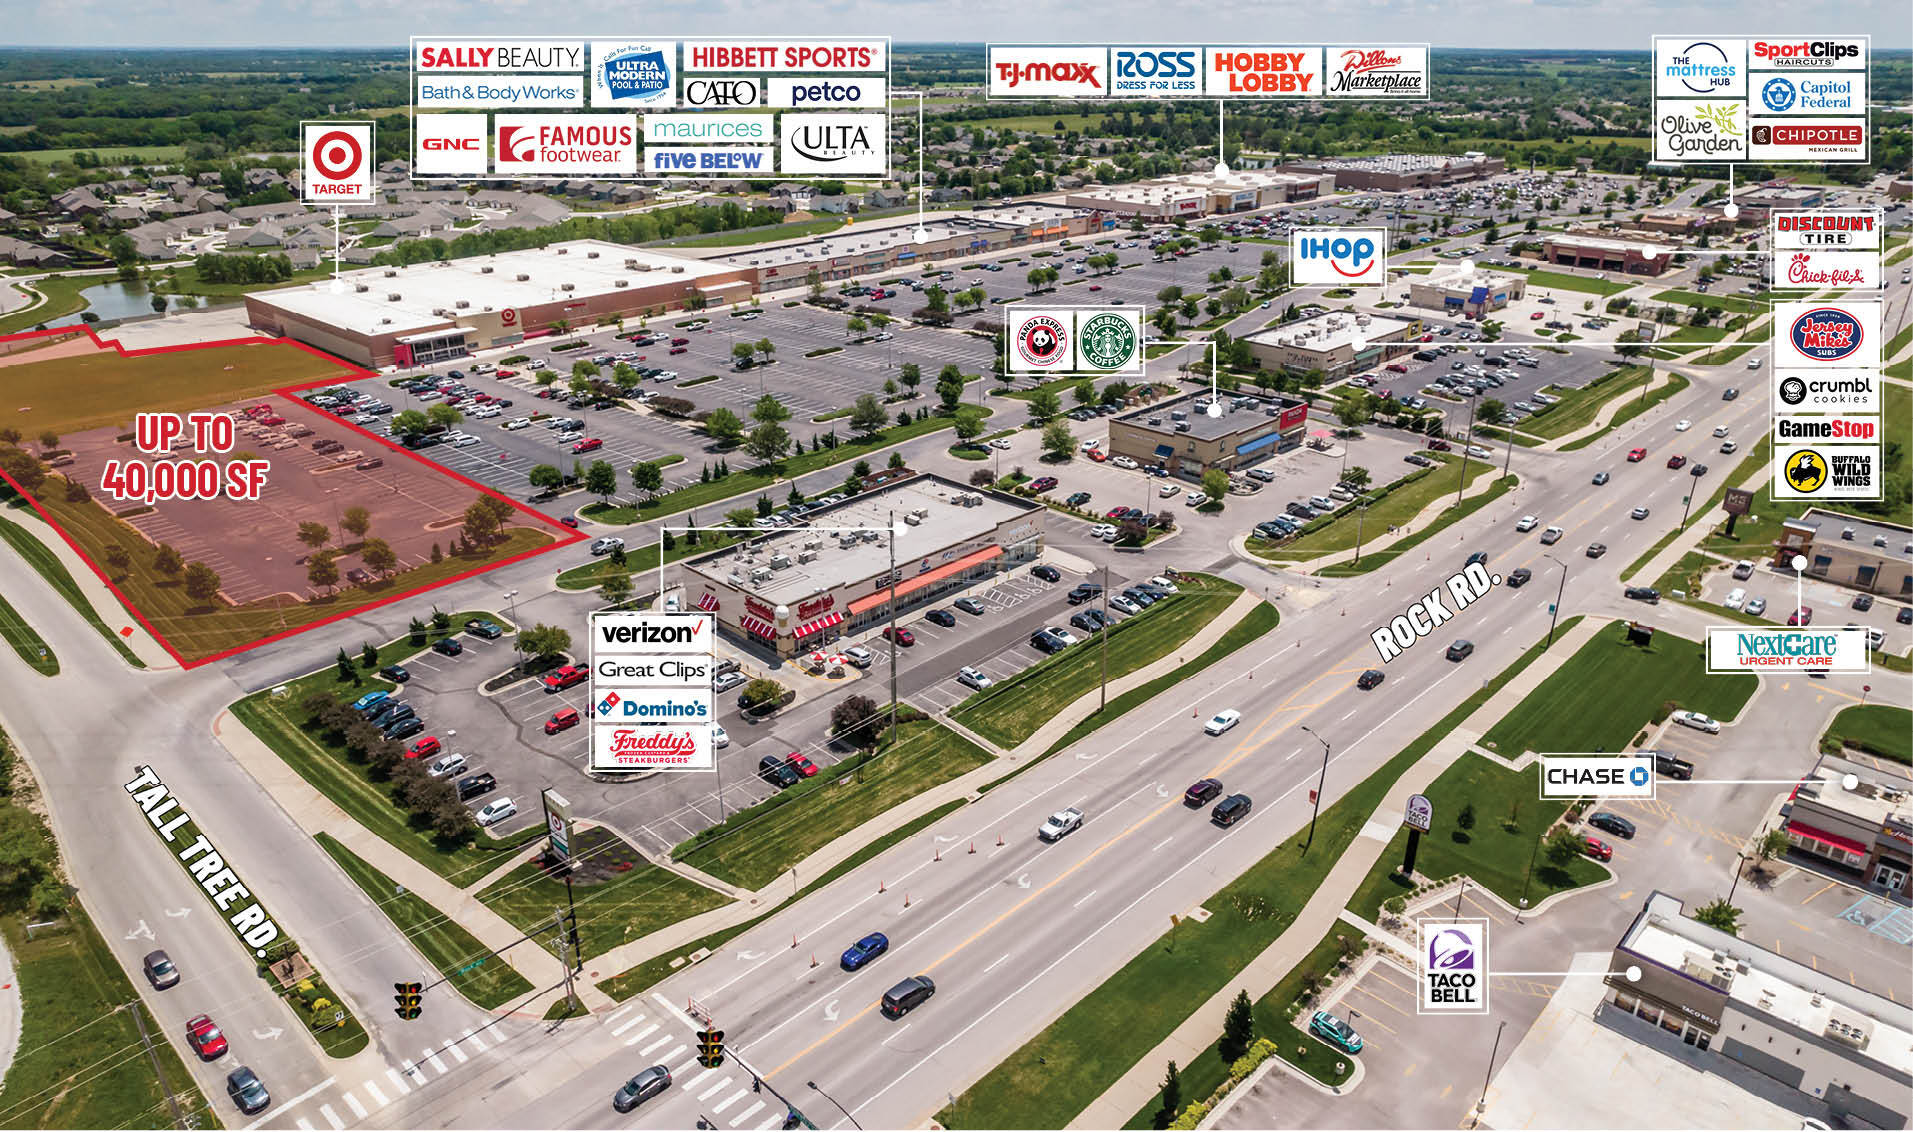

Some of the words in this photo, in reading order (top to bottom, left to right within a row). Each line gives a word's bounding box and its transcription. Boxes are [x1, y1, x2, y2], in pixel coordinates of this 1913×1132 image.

[1408, 810, 1428, 822] TACO
[1408, 817, 1426, 827] BELL
[1681, 1005, 1700, 1018] TACO
[1701, 1014, 1719, 1026] BELL
